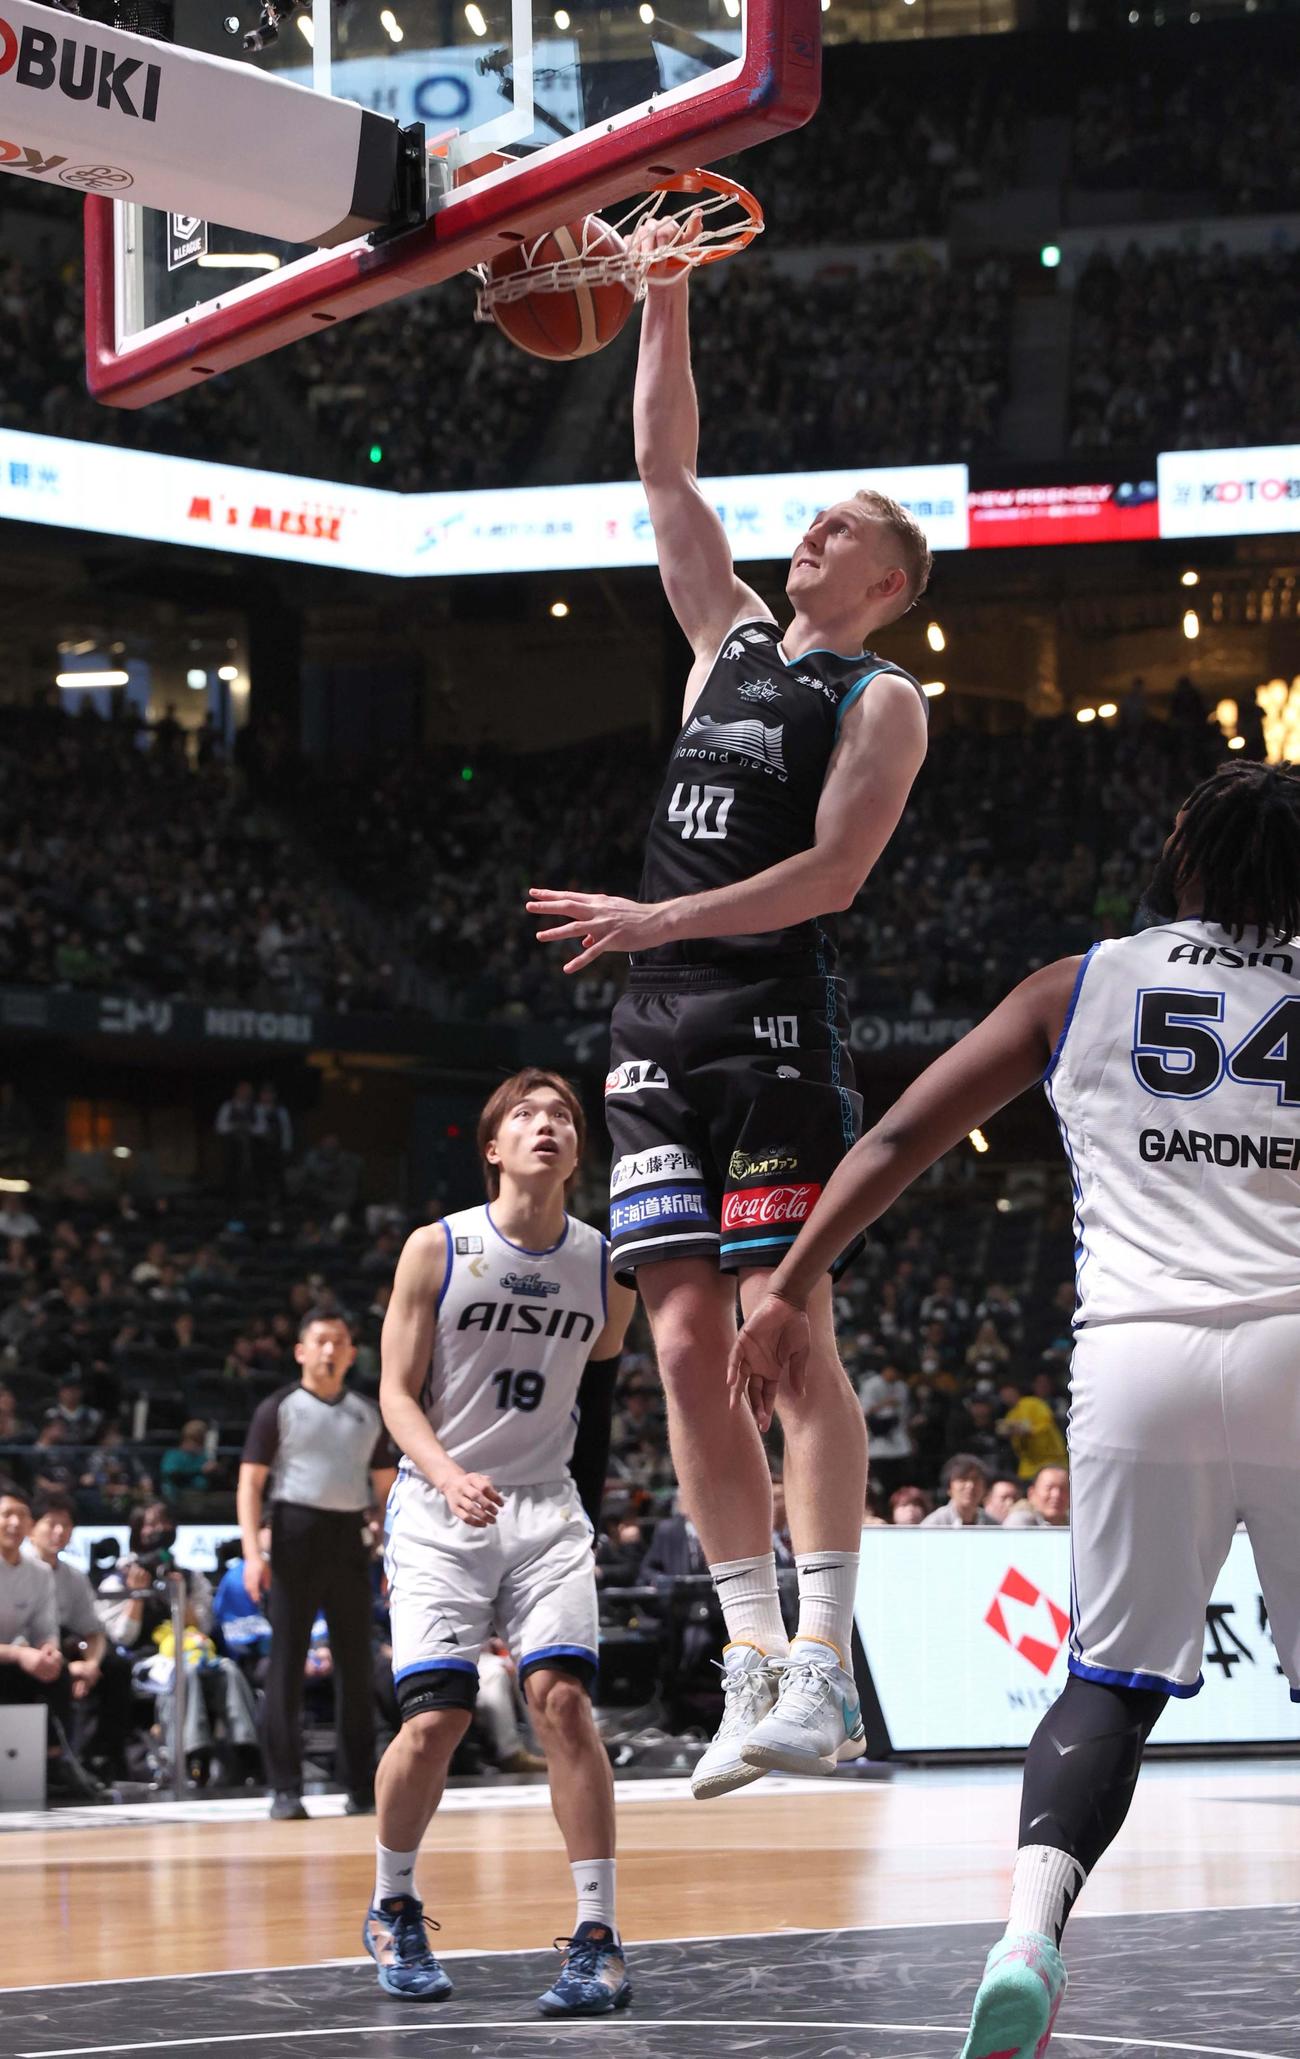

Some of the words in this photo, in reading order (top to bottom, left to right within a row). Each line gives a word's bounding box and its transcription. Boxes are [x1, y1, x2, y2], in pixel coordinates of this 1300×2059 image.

[249, 505, 341, 542] MESSE
[668, 782, 735, 840] 40
[1167, 943, 1294, 975] AISIN
[204, 1007, 313, 1043] NITORI
[753, 1015, 800, 1049] 40
[1131, 987, 1300, 1108] 54
[1138, 1128, 1300, 1171] GARDNE
[611, 1193, 704, 1232] 北海道新聞
[456, 1302, 594, 1342] AISIN
[491, 1368, 545, 1412] 19
